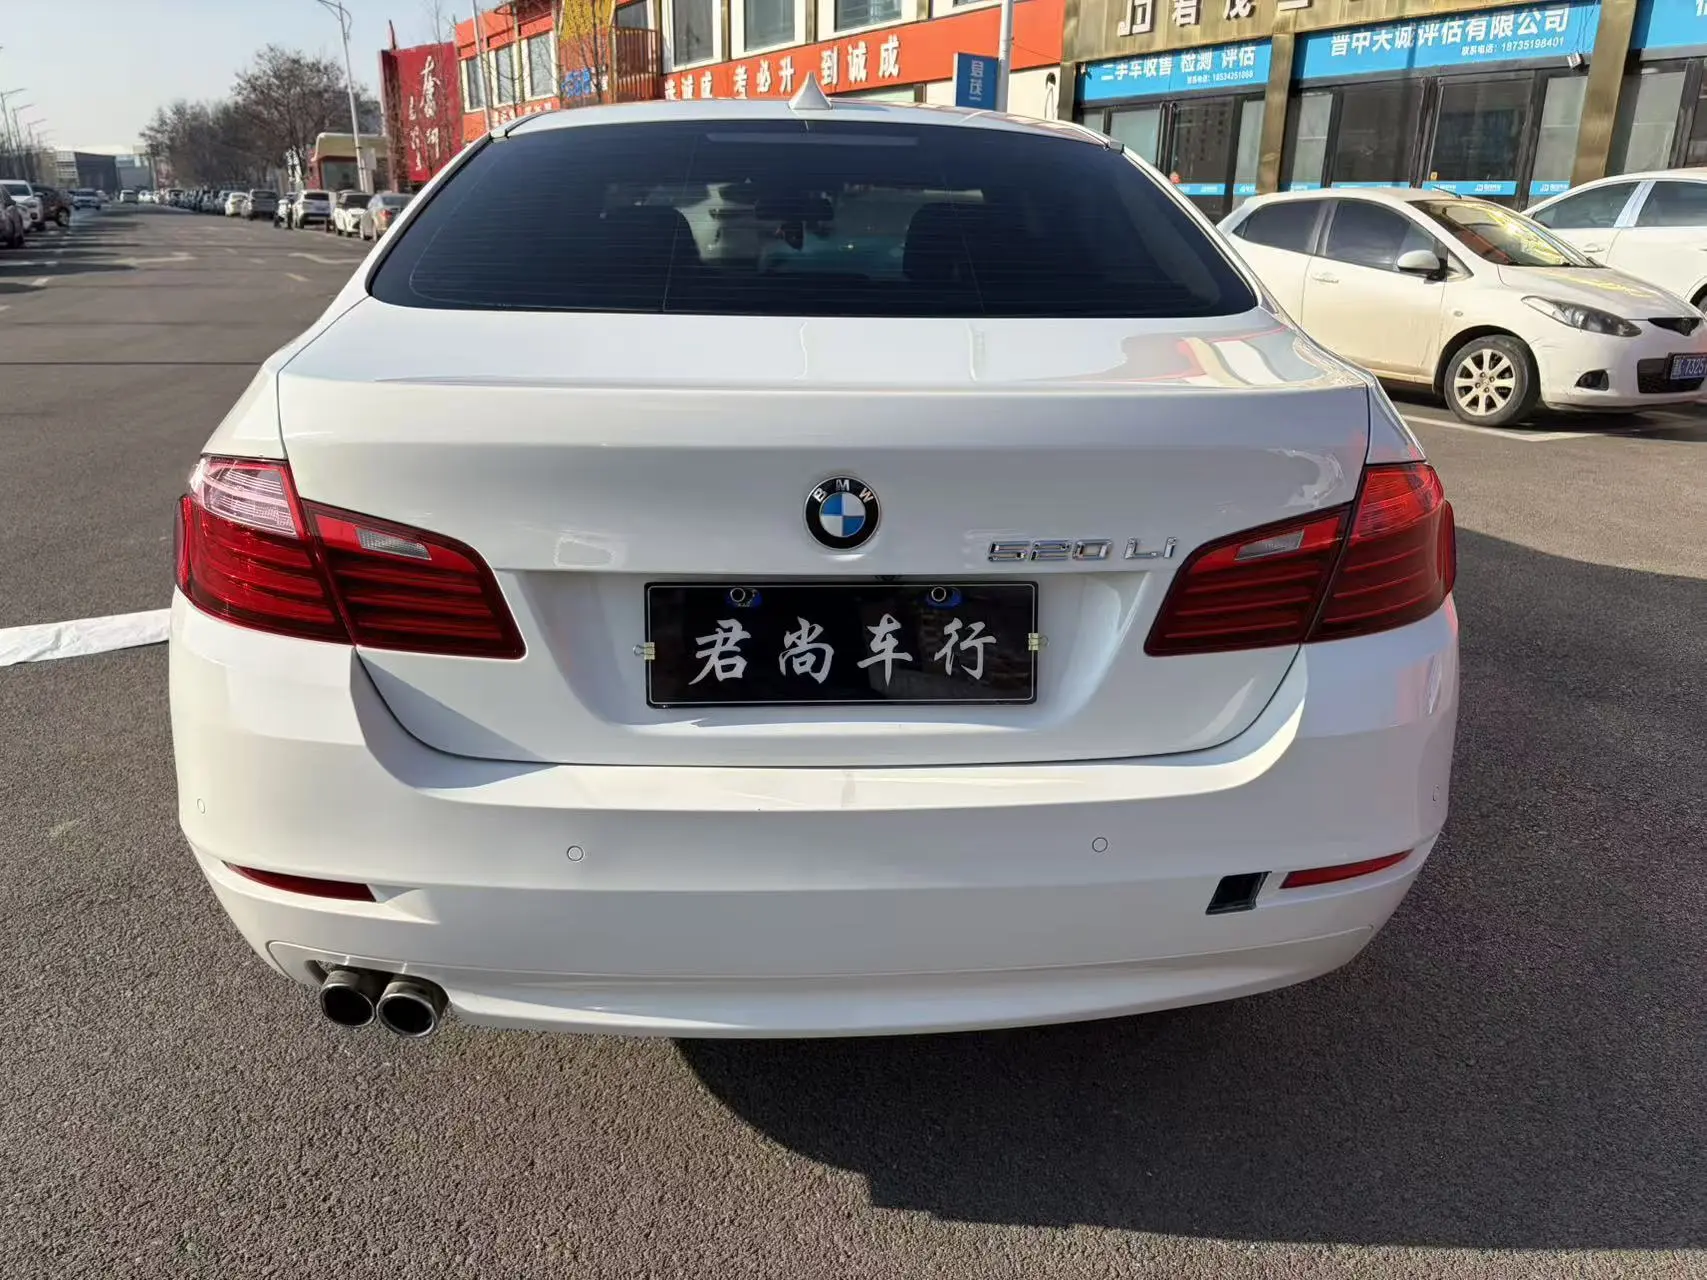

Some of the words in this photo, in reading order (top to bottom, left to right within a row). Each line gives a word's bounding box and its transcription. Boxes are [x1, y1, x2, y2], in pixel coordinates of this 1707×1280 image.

[1502, 37, 1564, 52] 18735198401
[820, 34, 901, 86] 到诚成
[1181, 49, 1213, 73] 检测
[1220, 46, 1256, 68] 评估
[812, 479, 874, 503] BMW
[988, 540, 1112, 562] 520
[688, 613, 997, 686] 君尚车行
